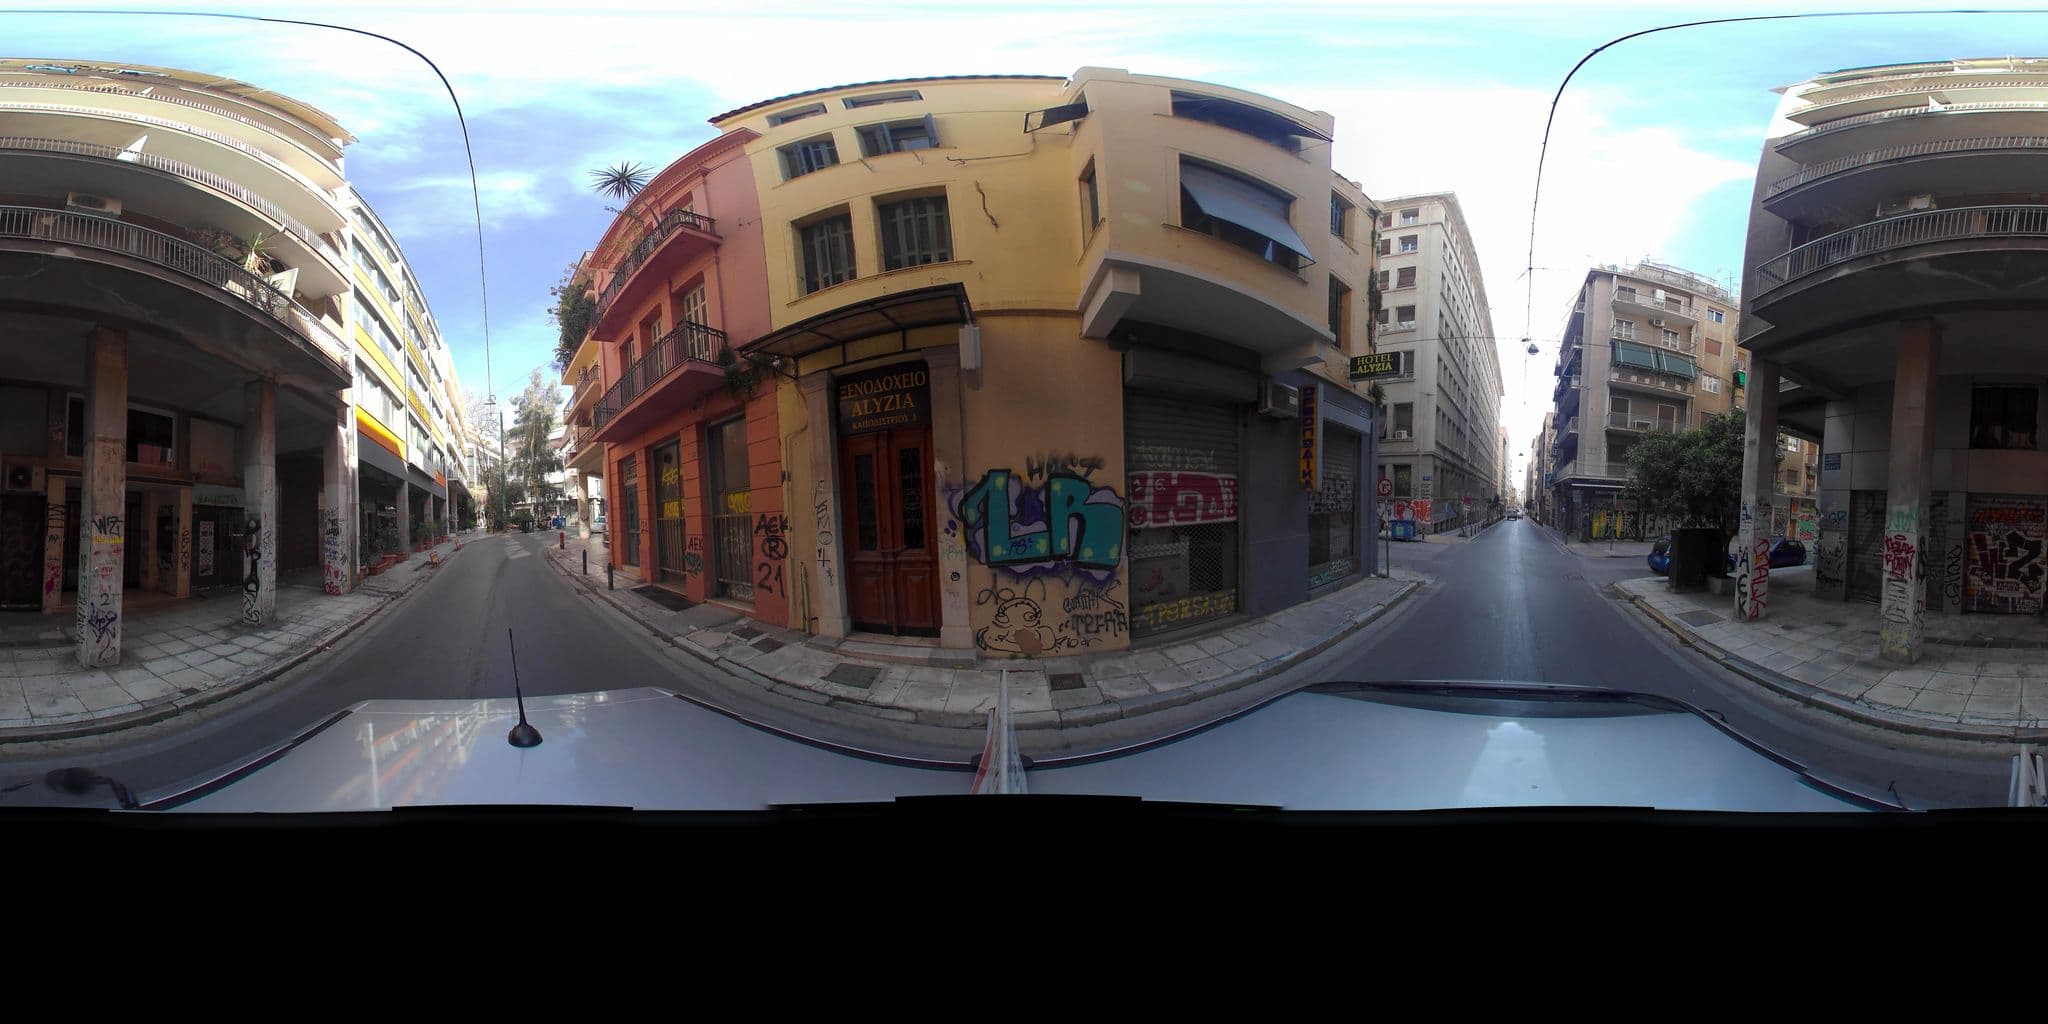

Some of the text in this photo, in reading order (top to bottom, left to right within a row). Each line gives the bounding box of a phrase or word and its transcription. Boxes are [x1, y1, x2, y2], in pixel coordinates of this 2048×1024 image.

[1357, 353, 1393, 365] HOTEL
[1357, 362, 1393, 374] ALYZIA
[840, 371, 926, 400] ΞΕΝΟΔΟΧΕΙΟ
[852, 392, 915, 416] ALYZIA
[755, 562, 785, 600] 21
